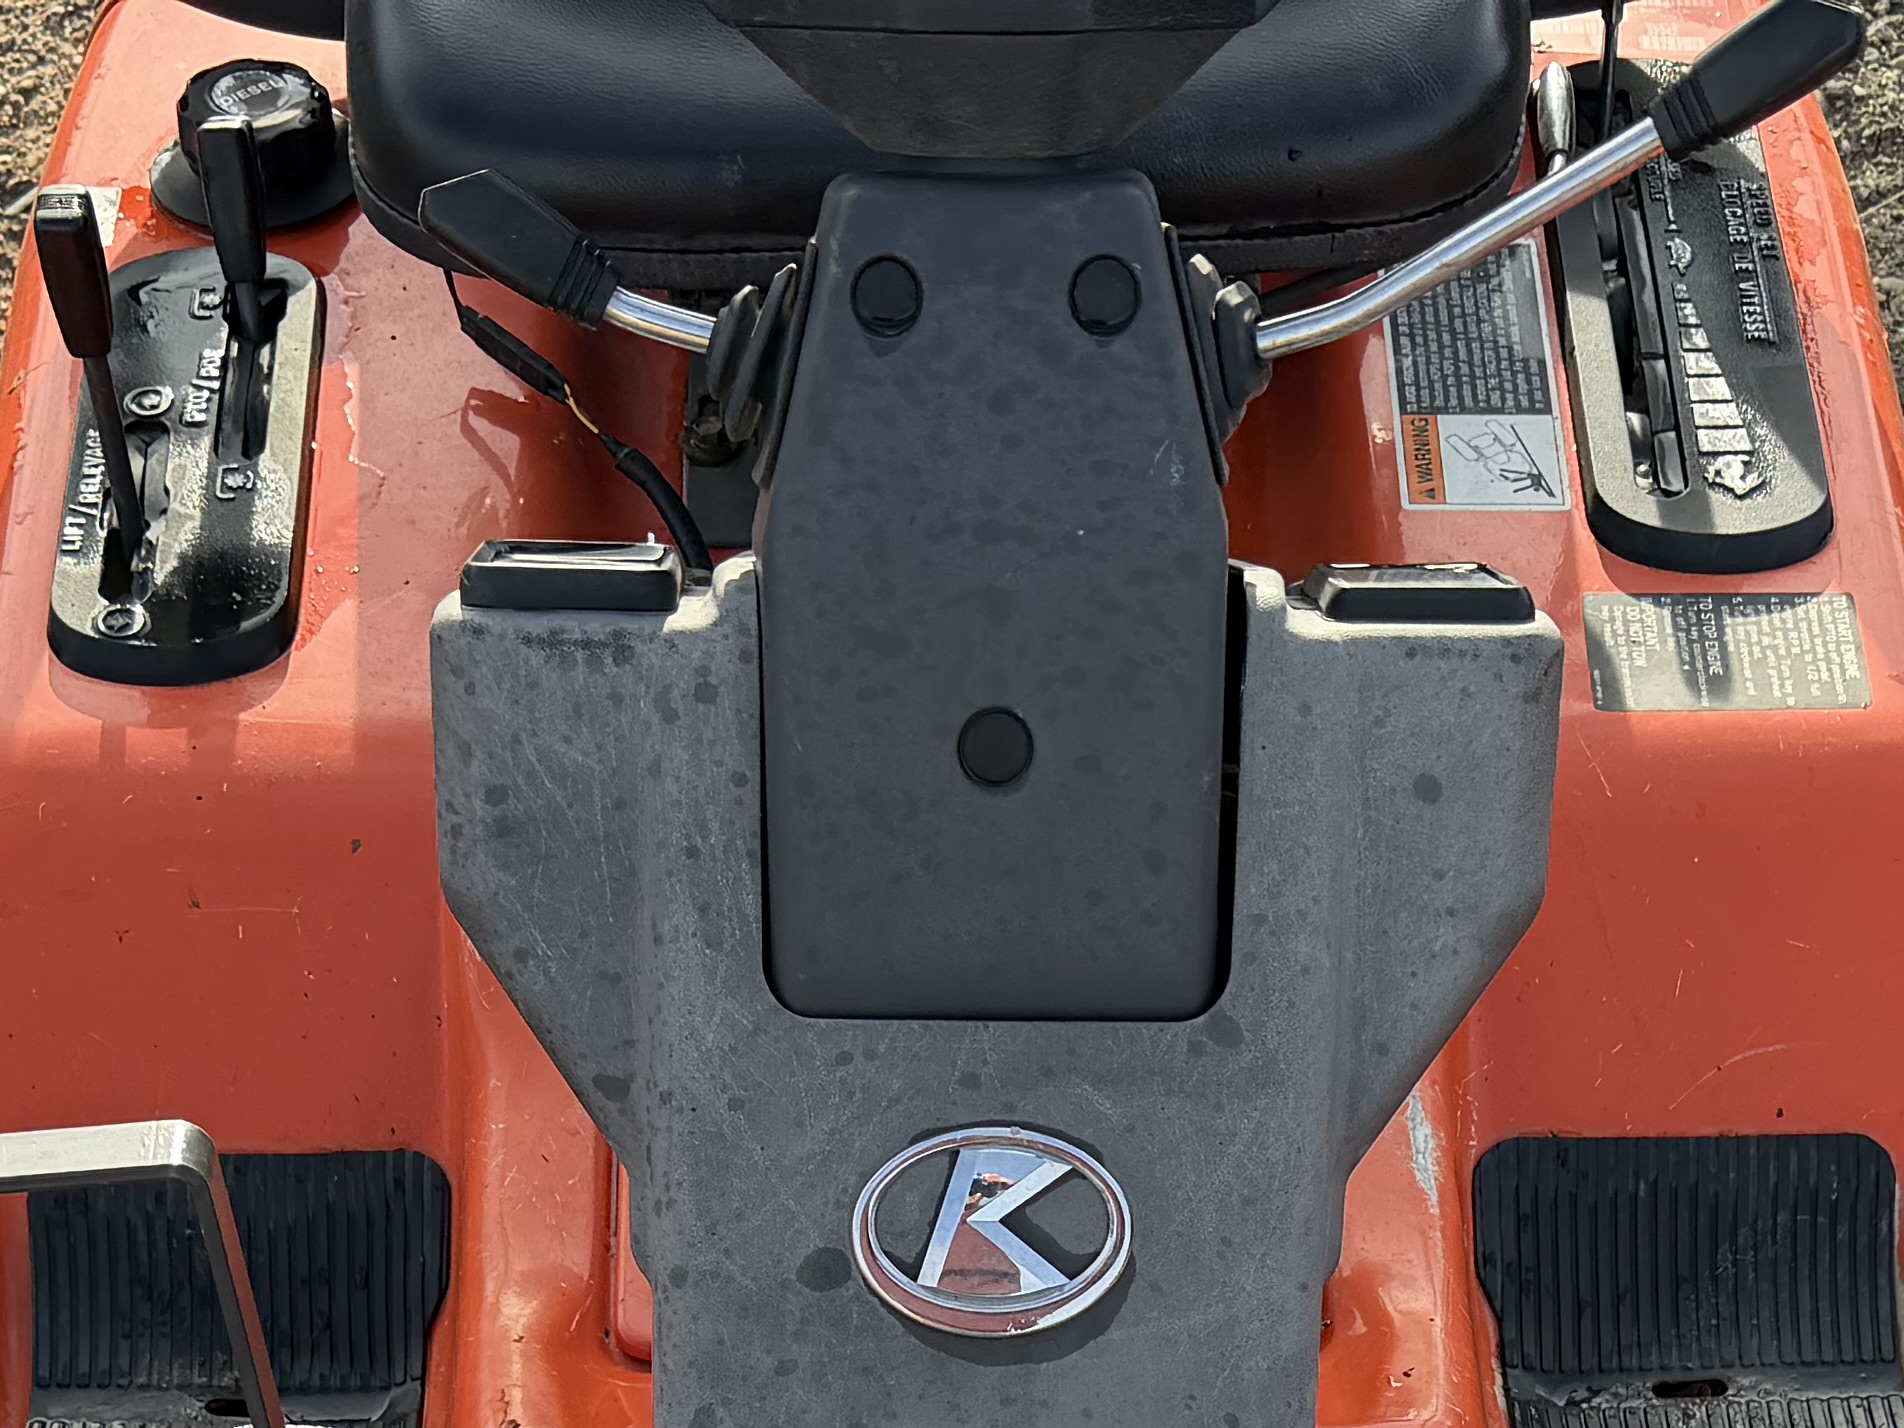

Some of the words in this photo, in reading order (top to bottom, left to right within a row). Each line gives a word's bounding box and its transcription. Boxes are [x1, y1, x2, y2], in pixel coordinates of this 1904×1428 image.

[218, 79, 285, 105] DIESEL
[1738, 281, 1769, 341] VITESSE
[1410, 418, 1434, 484] WARNING
[1626, 606, 1640, 620] DO
[1699, 596, 1712, 610] TO
[1832, 595, 1847, 608] TO
[1629, 623, 1644, 642] NOT
[1701, 612, 1717, 638] STOP
[1834, 611, 1853, 642] START
[1632, 646, 1646, 667] TOW
[1705, 641, 1723, 676] ENGINE
[1841, 644, 1860, 679] ENGINE
